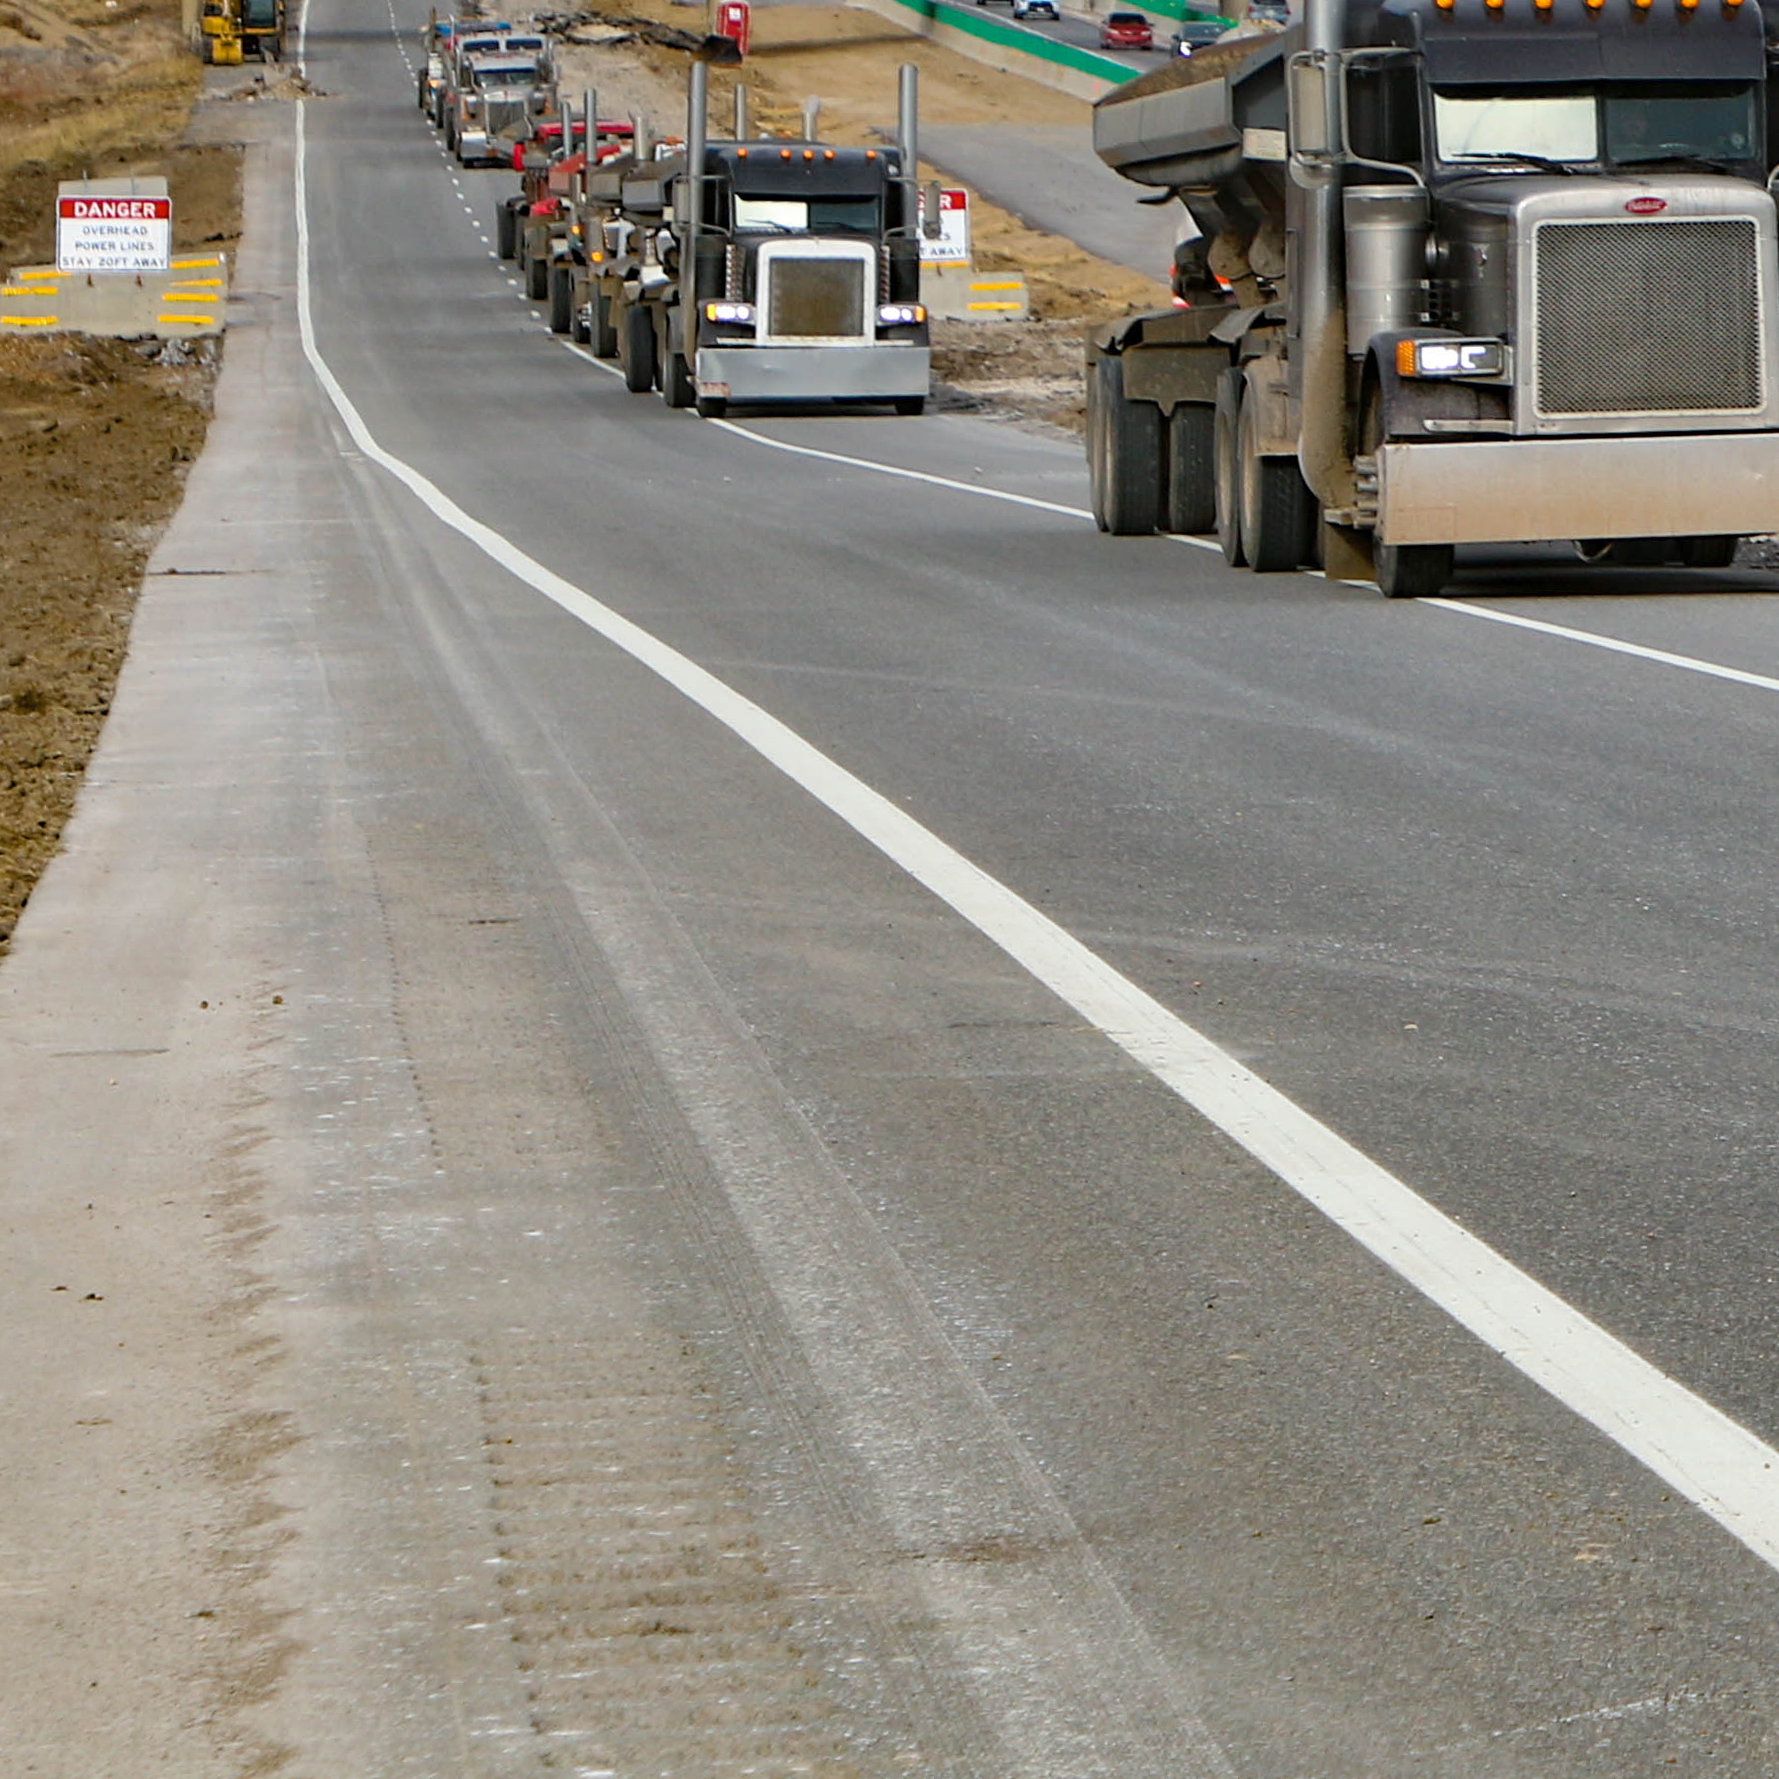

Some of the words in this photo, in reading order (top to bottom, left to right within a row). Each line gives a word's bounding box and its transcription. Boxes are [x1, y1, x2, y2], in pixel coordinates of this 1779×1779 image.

[74, 201, 156, 217] DANGER
[82, 225, 148, 235] OVERHEAD
[75, 241, 116, 252] POWER
[120, 241, 154, 252] LINES
[62, 256, 93, 267] STAY
[98, 256, 128, 267] 20FT
[133, 257, 166, 268] AWAY
